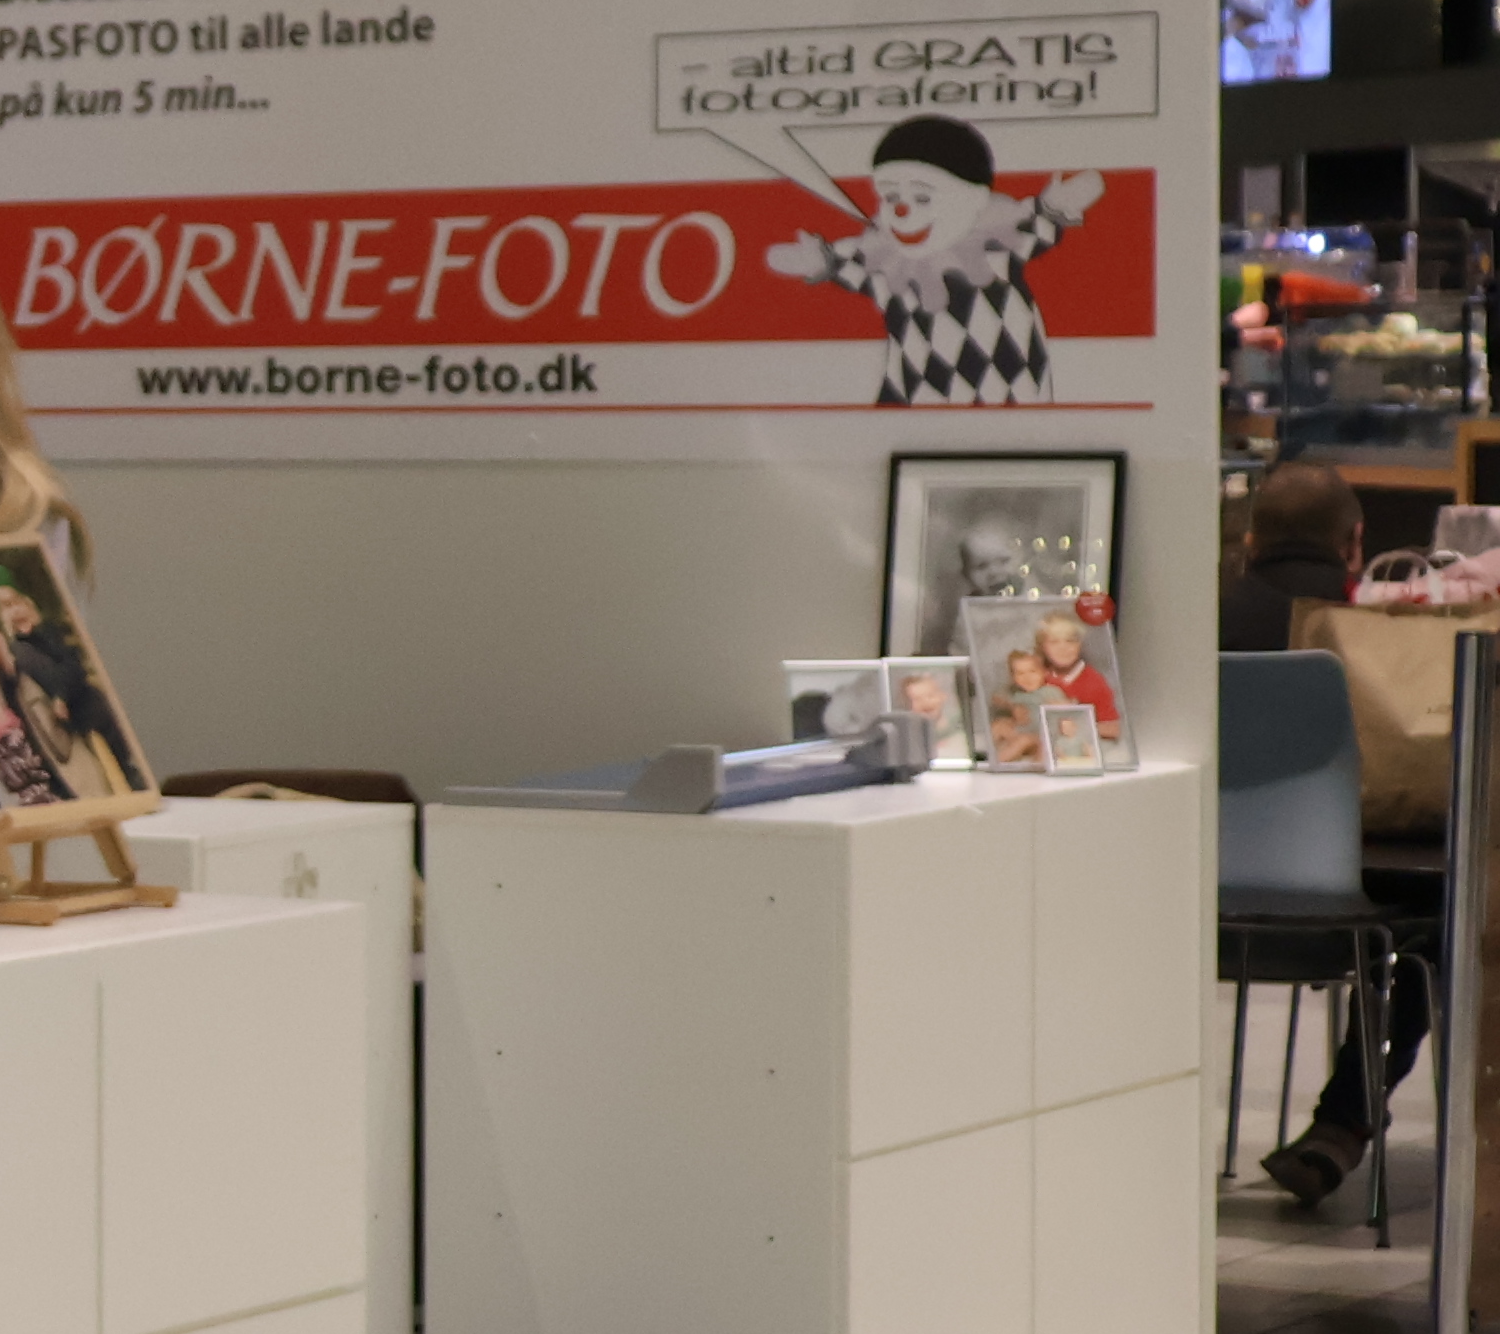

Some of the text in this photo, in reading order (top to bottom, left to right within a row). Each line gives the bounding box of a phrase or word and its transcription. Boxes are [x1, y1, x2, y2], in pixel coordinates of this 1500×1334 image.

[188, 14, 228, 53] til
[239, 11, 311, 51] alle
[320, 4, 436, 47] lande
[730, 45, 855, 79] altid
[873, 31, 1118, 69] GRATIS
[53, 80, 123, 117] kun
[132, 78, 155, 116] 5
[163, 74, 271, 115] min...
[680, 69, 1098, 117] fotografering!
[12, 209, 738, 334] BØRNE-FOTO
[136, 353, 598, 398] www.borne-foto.dk
